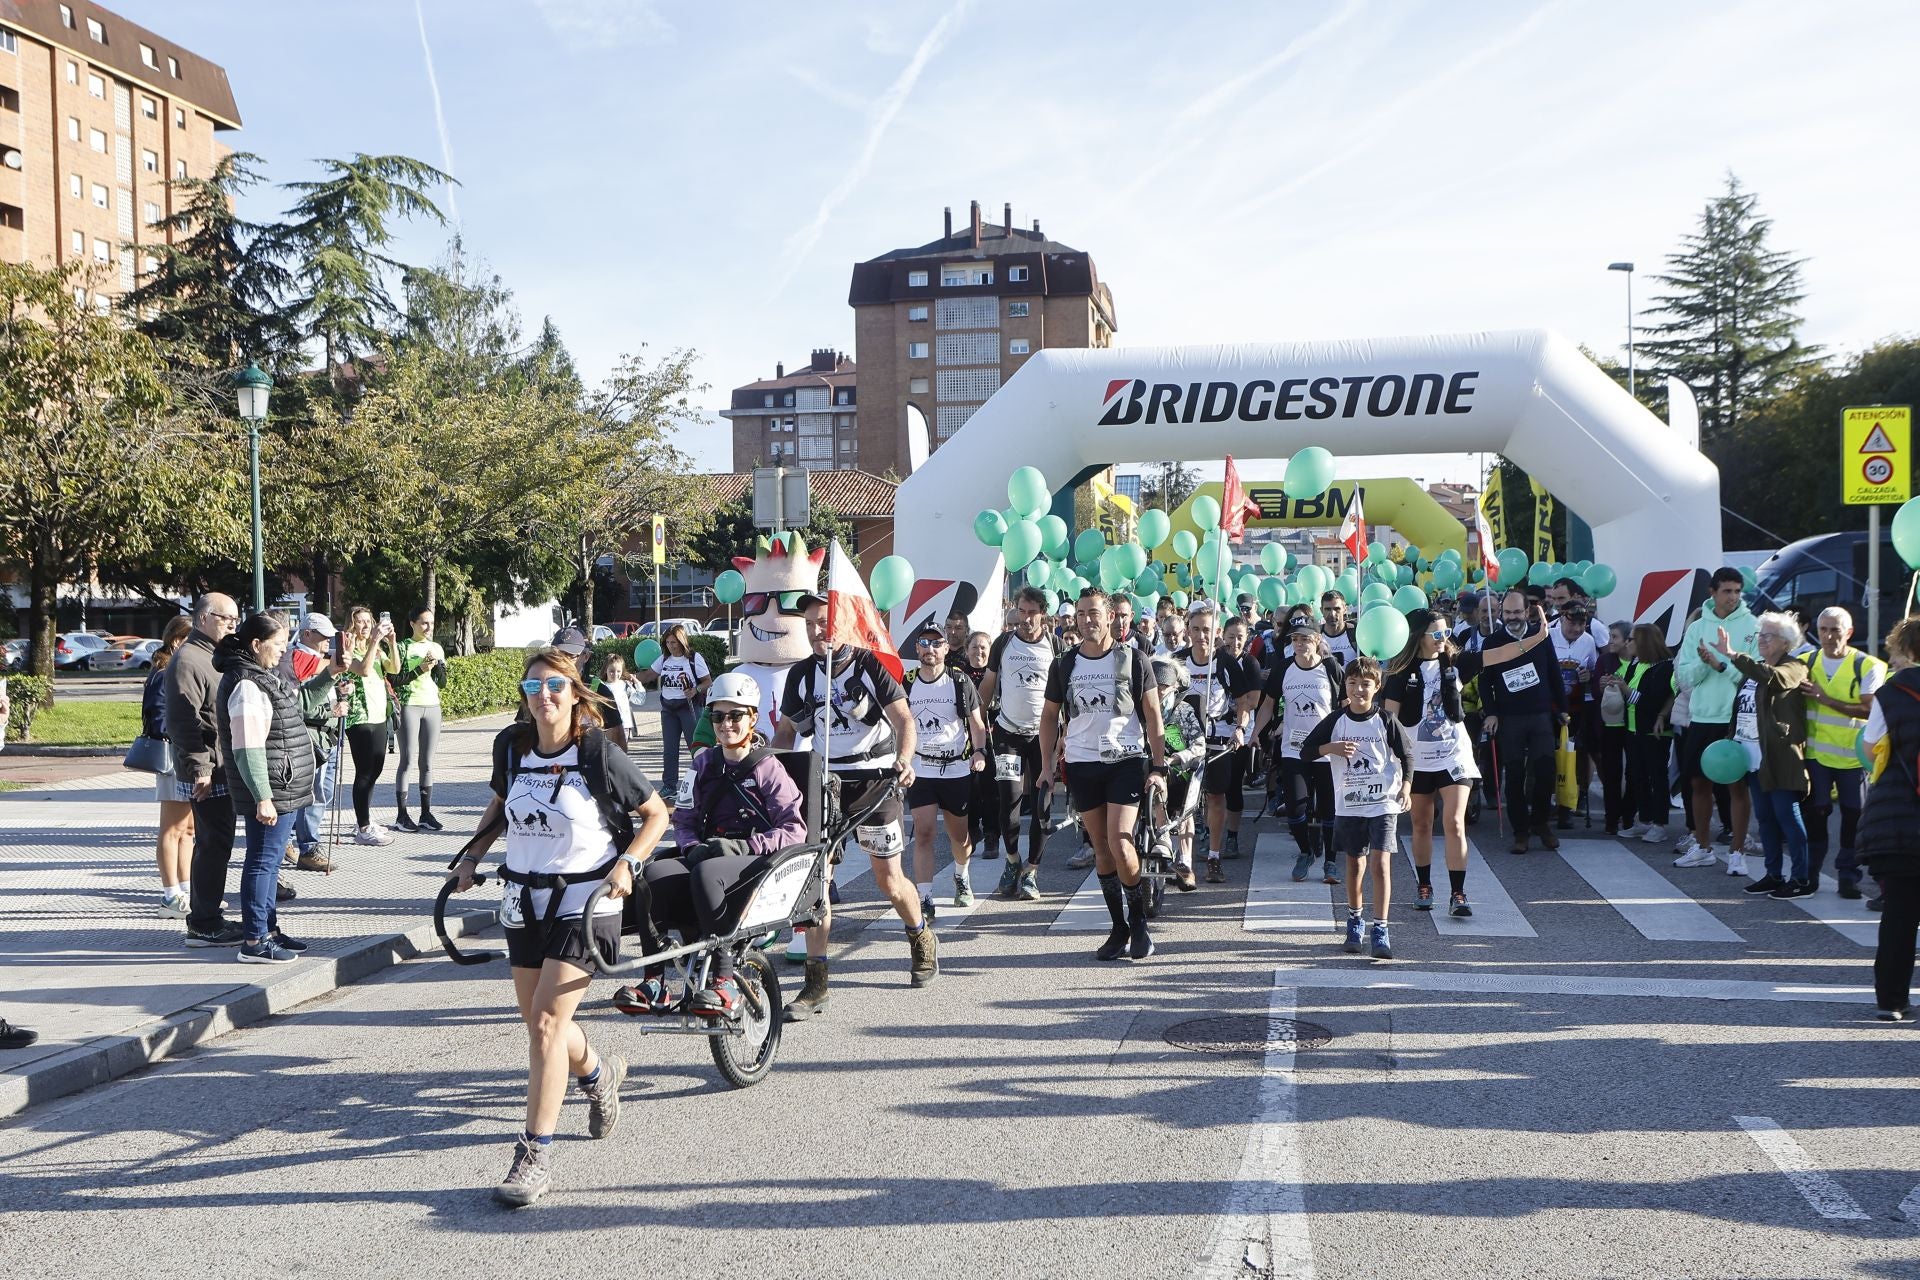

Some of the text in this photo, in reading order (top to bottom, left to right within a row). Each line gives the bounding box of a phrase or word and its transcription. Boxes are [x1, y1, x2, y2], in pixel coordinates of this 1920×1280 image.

[1098, 371, 1479, 426] BRIDGESTONE
[1848, 409, 1906, 421] ATENCIÓN
[1868, 465, 1887, 476] 30
[1857, 486, 1897, 494] CALZADA
[1293, 487, 1366, 519] BM
[1848, 493, 1905, 502] COMPARTIDA
[1521, 669, 1536, 681] 393
[1005, 762, 1020, 772] 336
[1367, 783, 1383, 795] 277
[885, 832, 897, 844] 94
